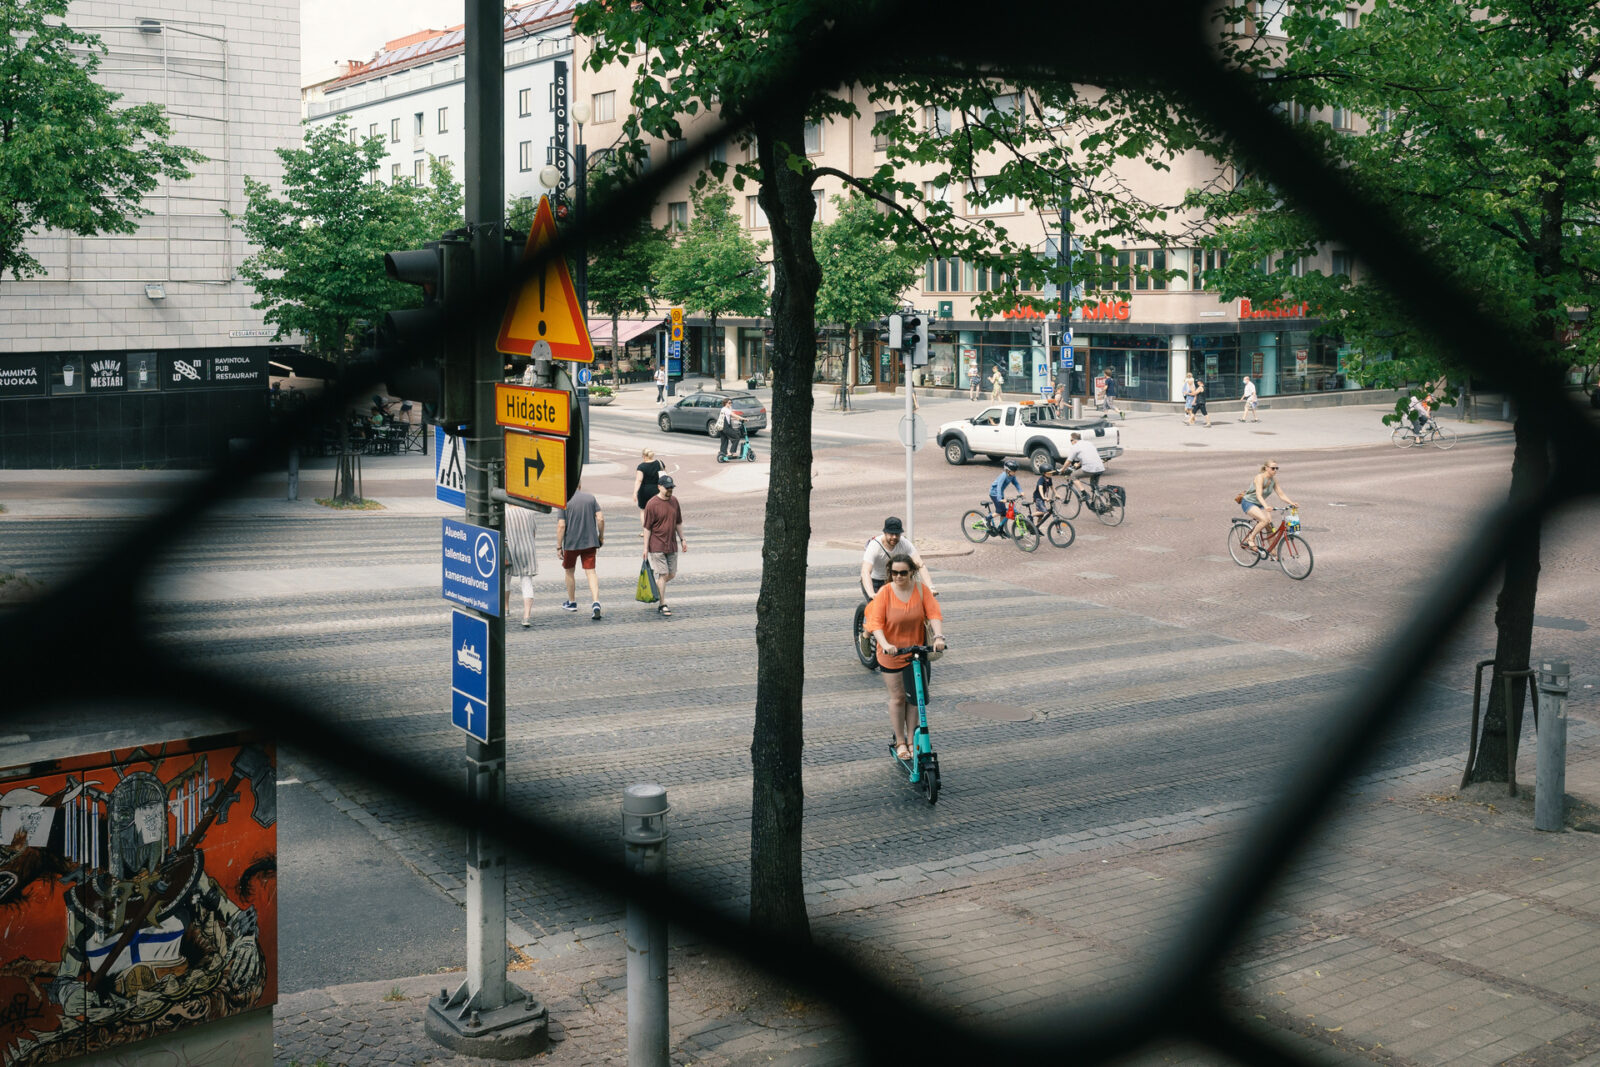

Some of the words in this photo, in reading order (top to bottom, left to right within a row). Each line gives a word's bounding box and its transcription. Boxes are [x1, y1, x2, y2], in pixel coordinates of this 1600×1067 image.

[557, 76, 565, 118] SOLO
[558, 124, 565, 144] BY
[558, 150, 566, 201] SOKOS
[90, 360, 121, 373] WANHA
[90, 376, 123, 388] MESTARI
[506, 395, 556, 423] Hidaste
[445, 547, 471, 564] tallentava
[445, 568, 488, 591] kameravalvonta
